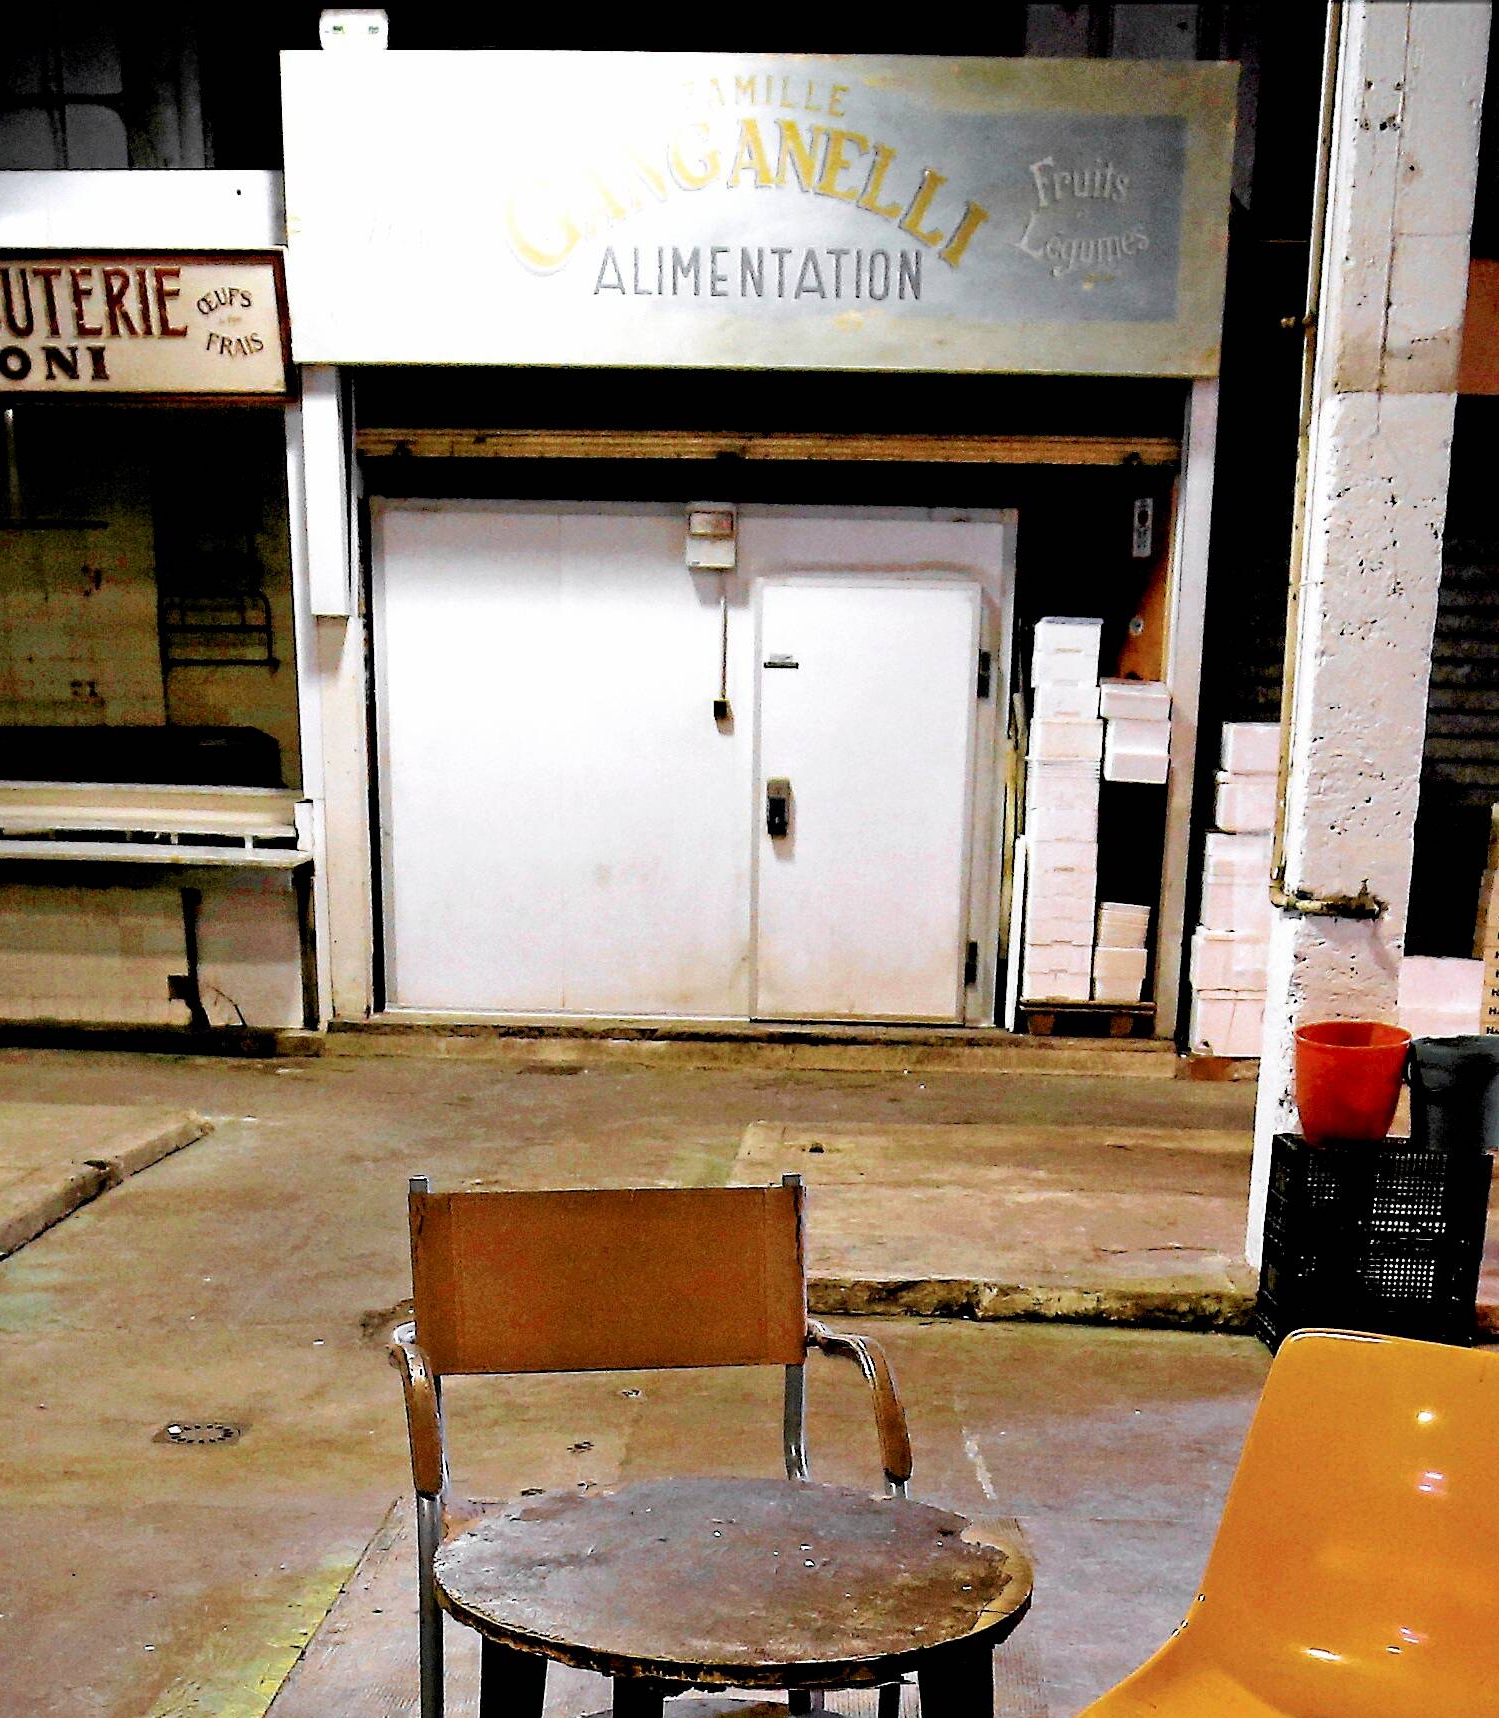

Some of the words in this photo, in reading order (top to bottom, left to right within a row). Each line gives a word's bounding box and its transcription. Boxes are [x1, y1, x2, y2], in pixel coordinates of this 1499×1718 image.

[1030, 156, 1129, 206] Fruits
[593, 246, 922, 300] ALIMENTATION
[206, 332, 265, 357] FRAIS
